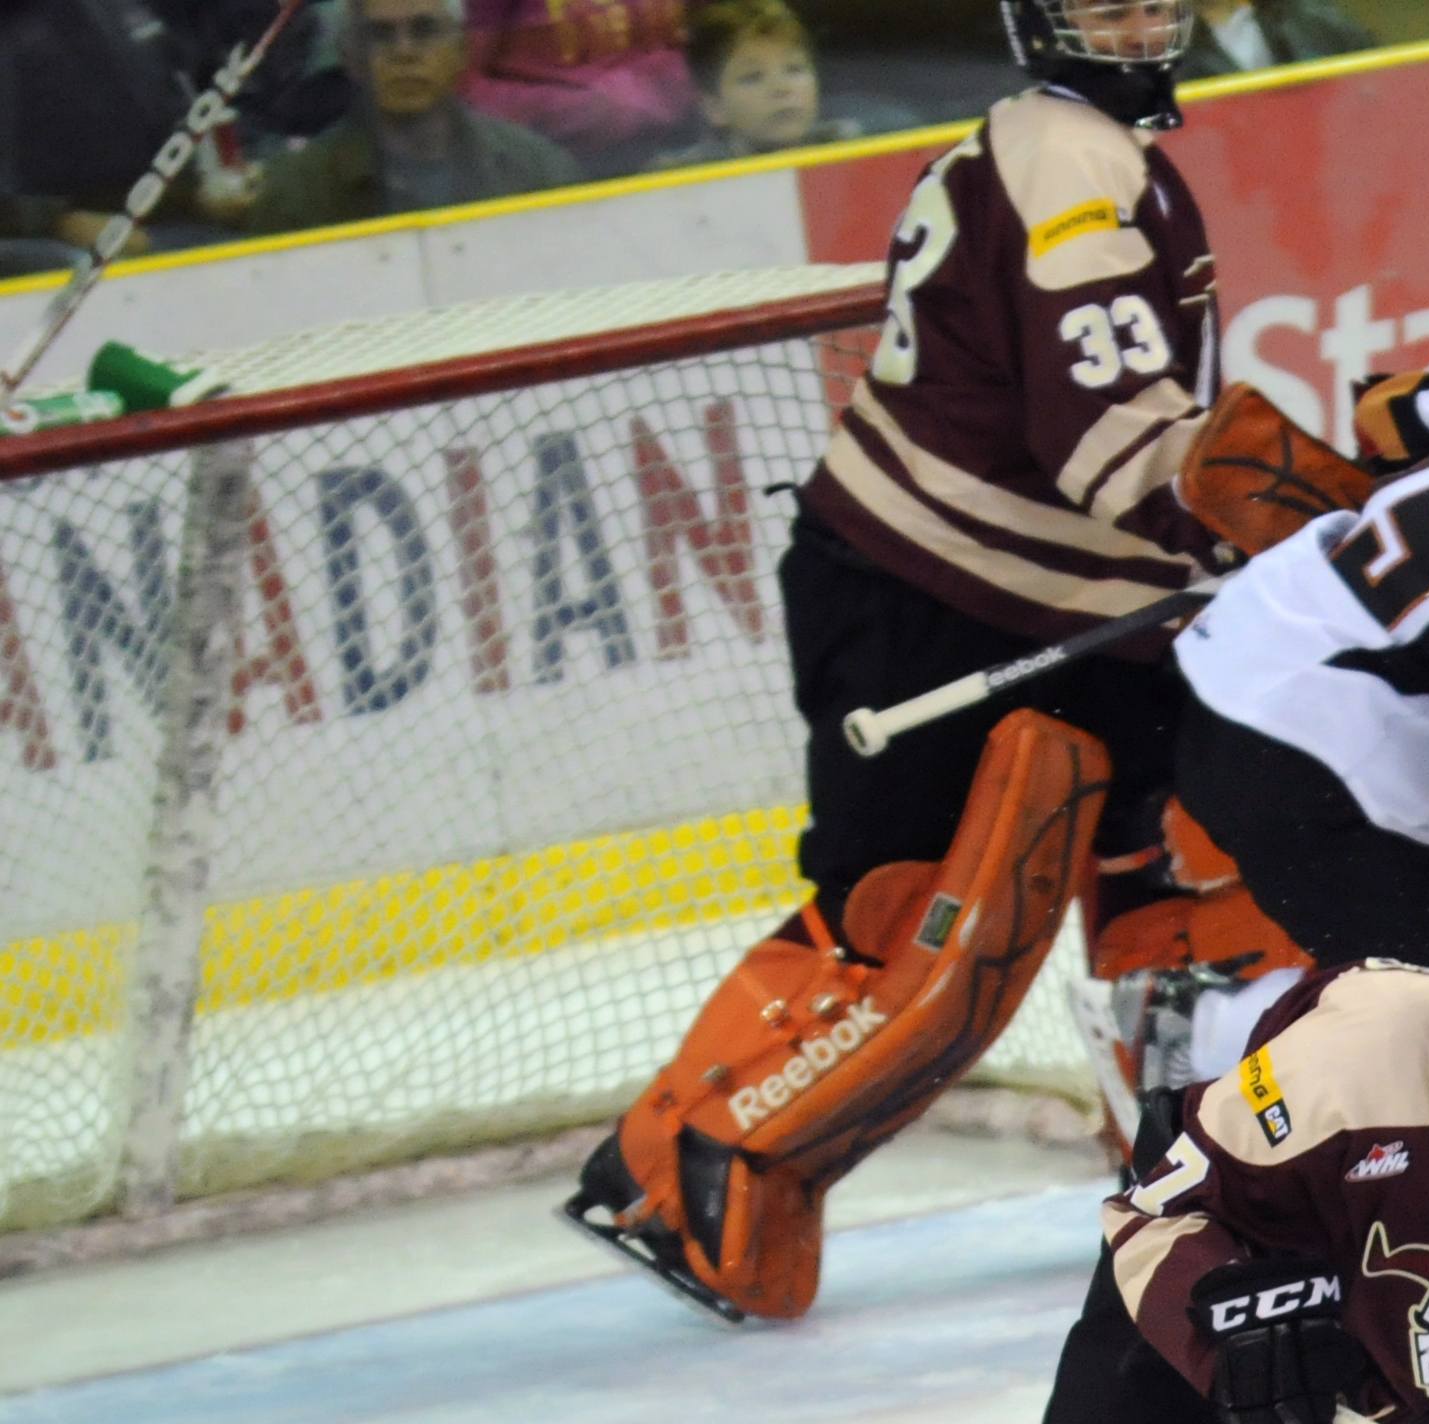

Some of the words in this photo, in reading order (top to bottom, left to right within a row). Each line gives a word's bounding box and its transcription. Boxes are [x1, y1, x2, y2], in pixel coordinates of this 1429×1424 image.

[1057, 293, 1173, 390] 33
[987, 644, 1068, 688] eebok
[727, 995, 889, 1131] Reebok
[1264, 1102, 1290, 1139] CAT
[1124, 1130, 1210, 1217] 7
[1209, 1274, 1342, 1332] CCM
